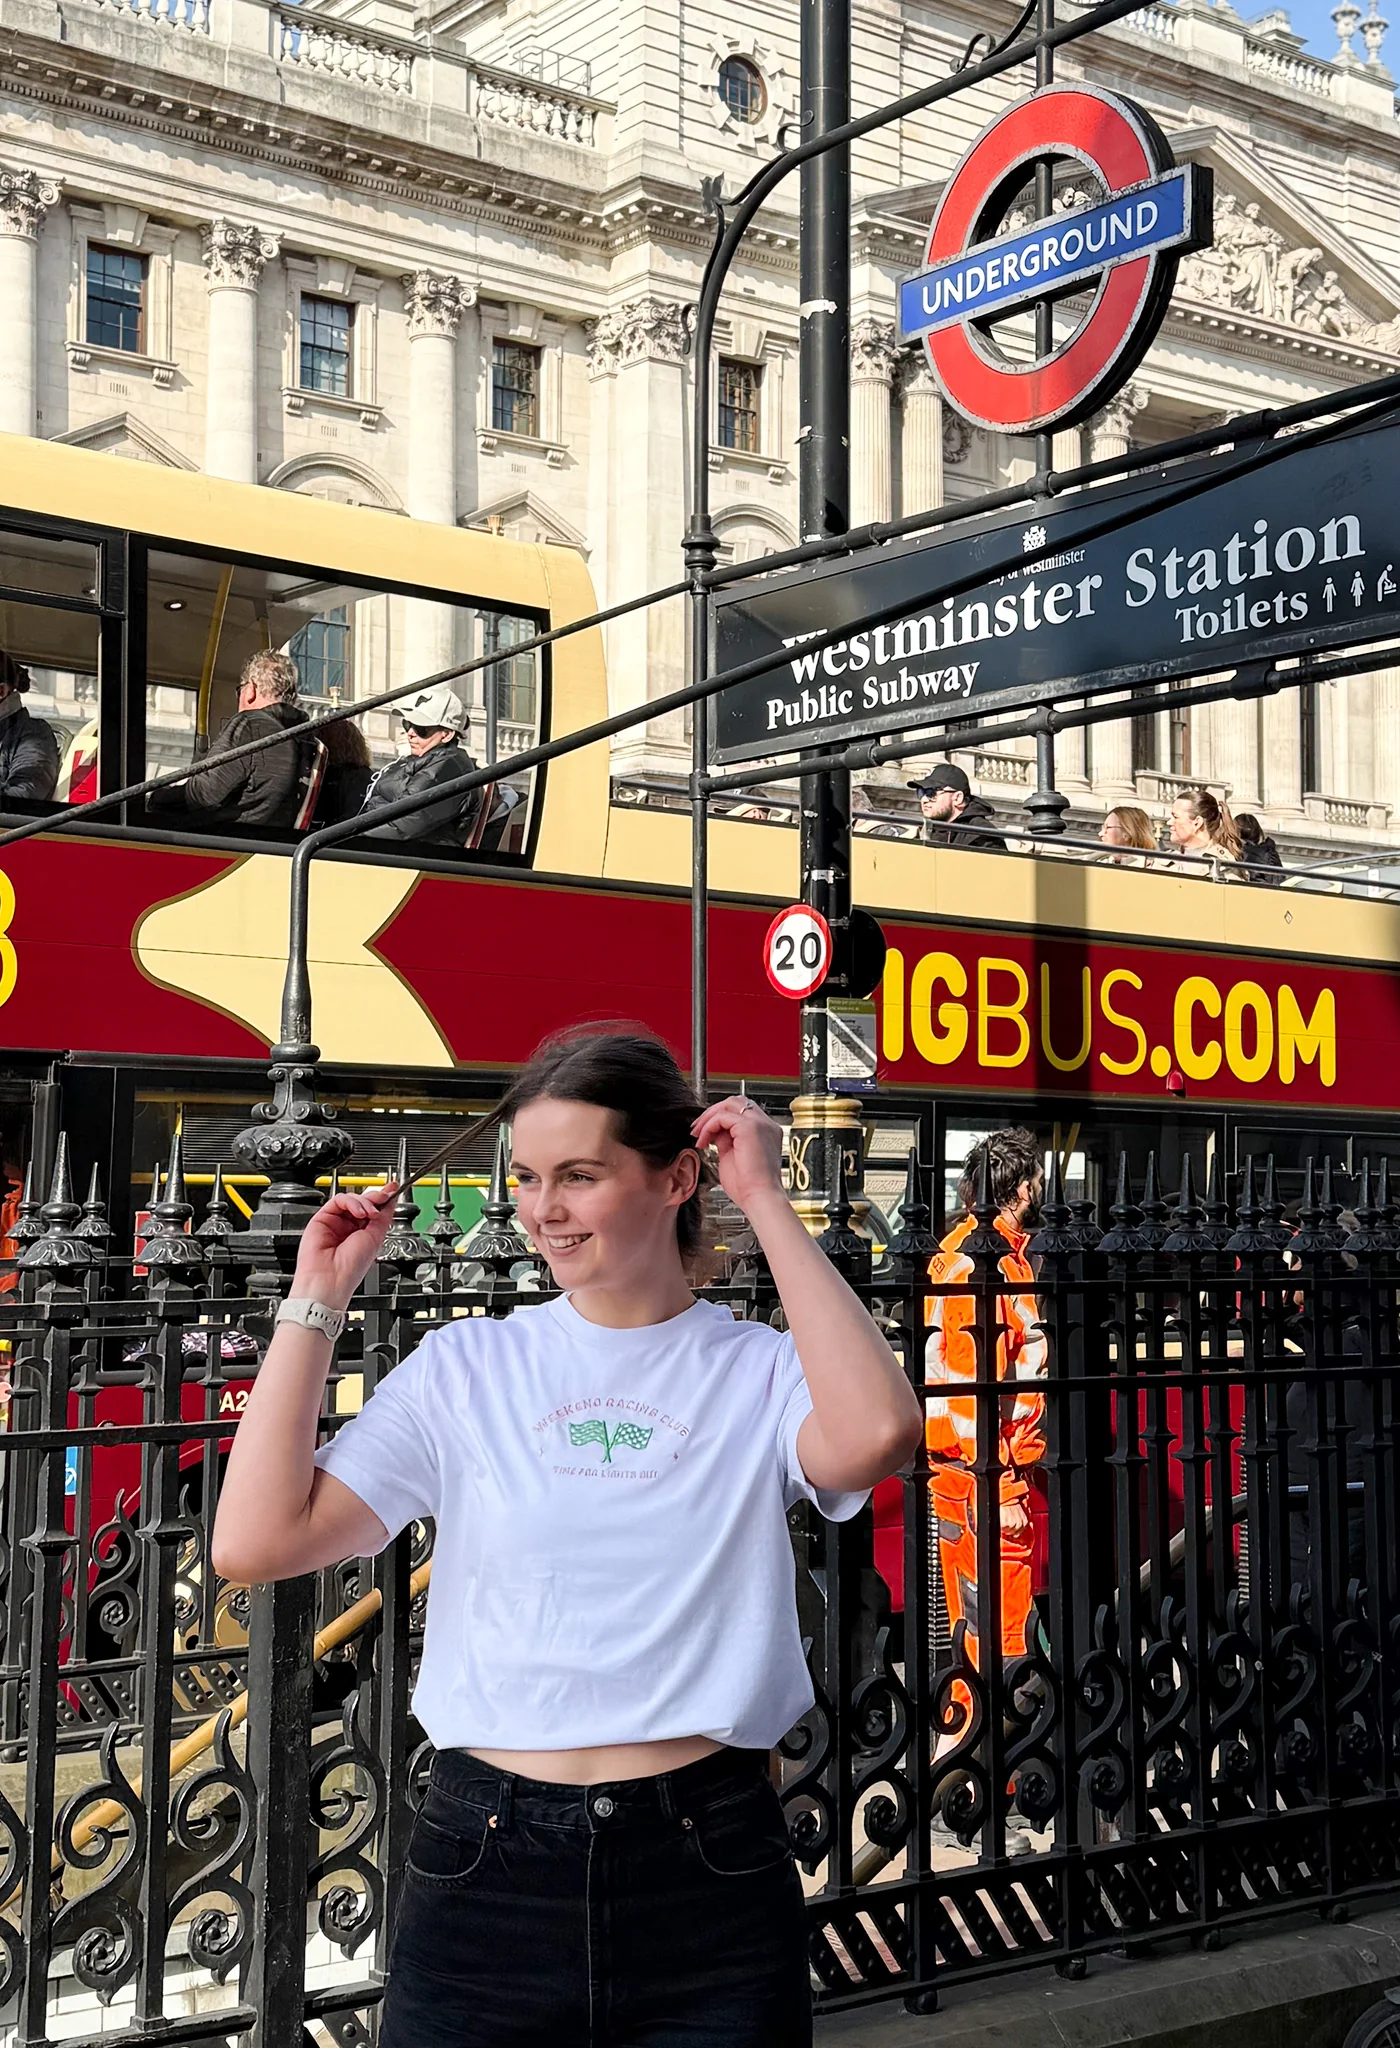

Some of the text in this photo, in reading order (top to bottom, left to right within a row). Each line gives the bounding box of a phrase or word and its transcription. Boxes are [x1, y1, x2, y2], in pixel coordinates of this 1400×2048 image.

[922, 200, 1159, 315] UNDERGROUND
[781, 514, 1366, 685] Westminster Station
[1174, 590, 1309, 643] Toilets
[766, 661, 981, 731] Public Subway
[775, 932, 822, 971] 20
[883, 947, 1337, 1088] IGBUS.COM
[219, 1390, 249, 1413] A2
